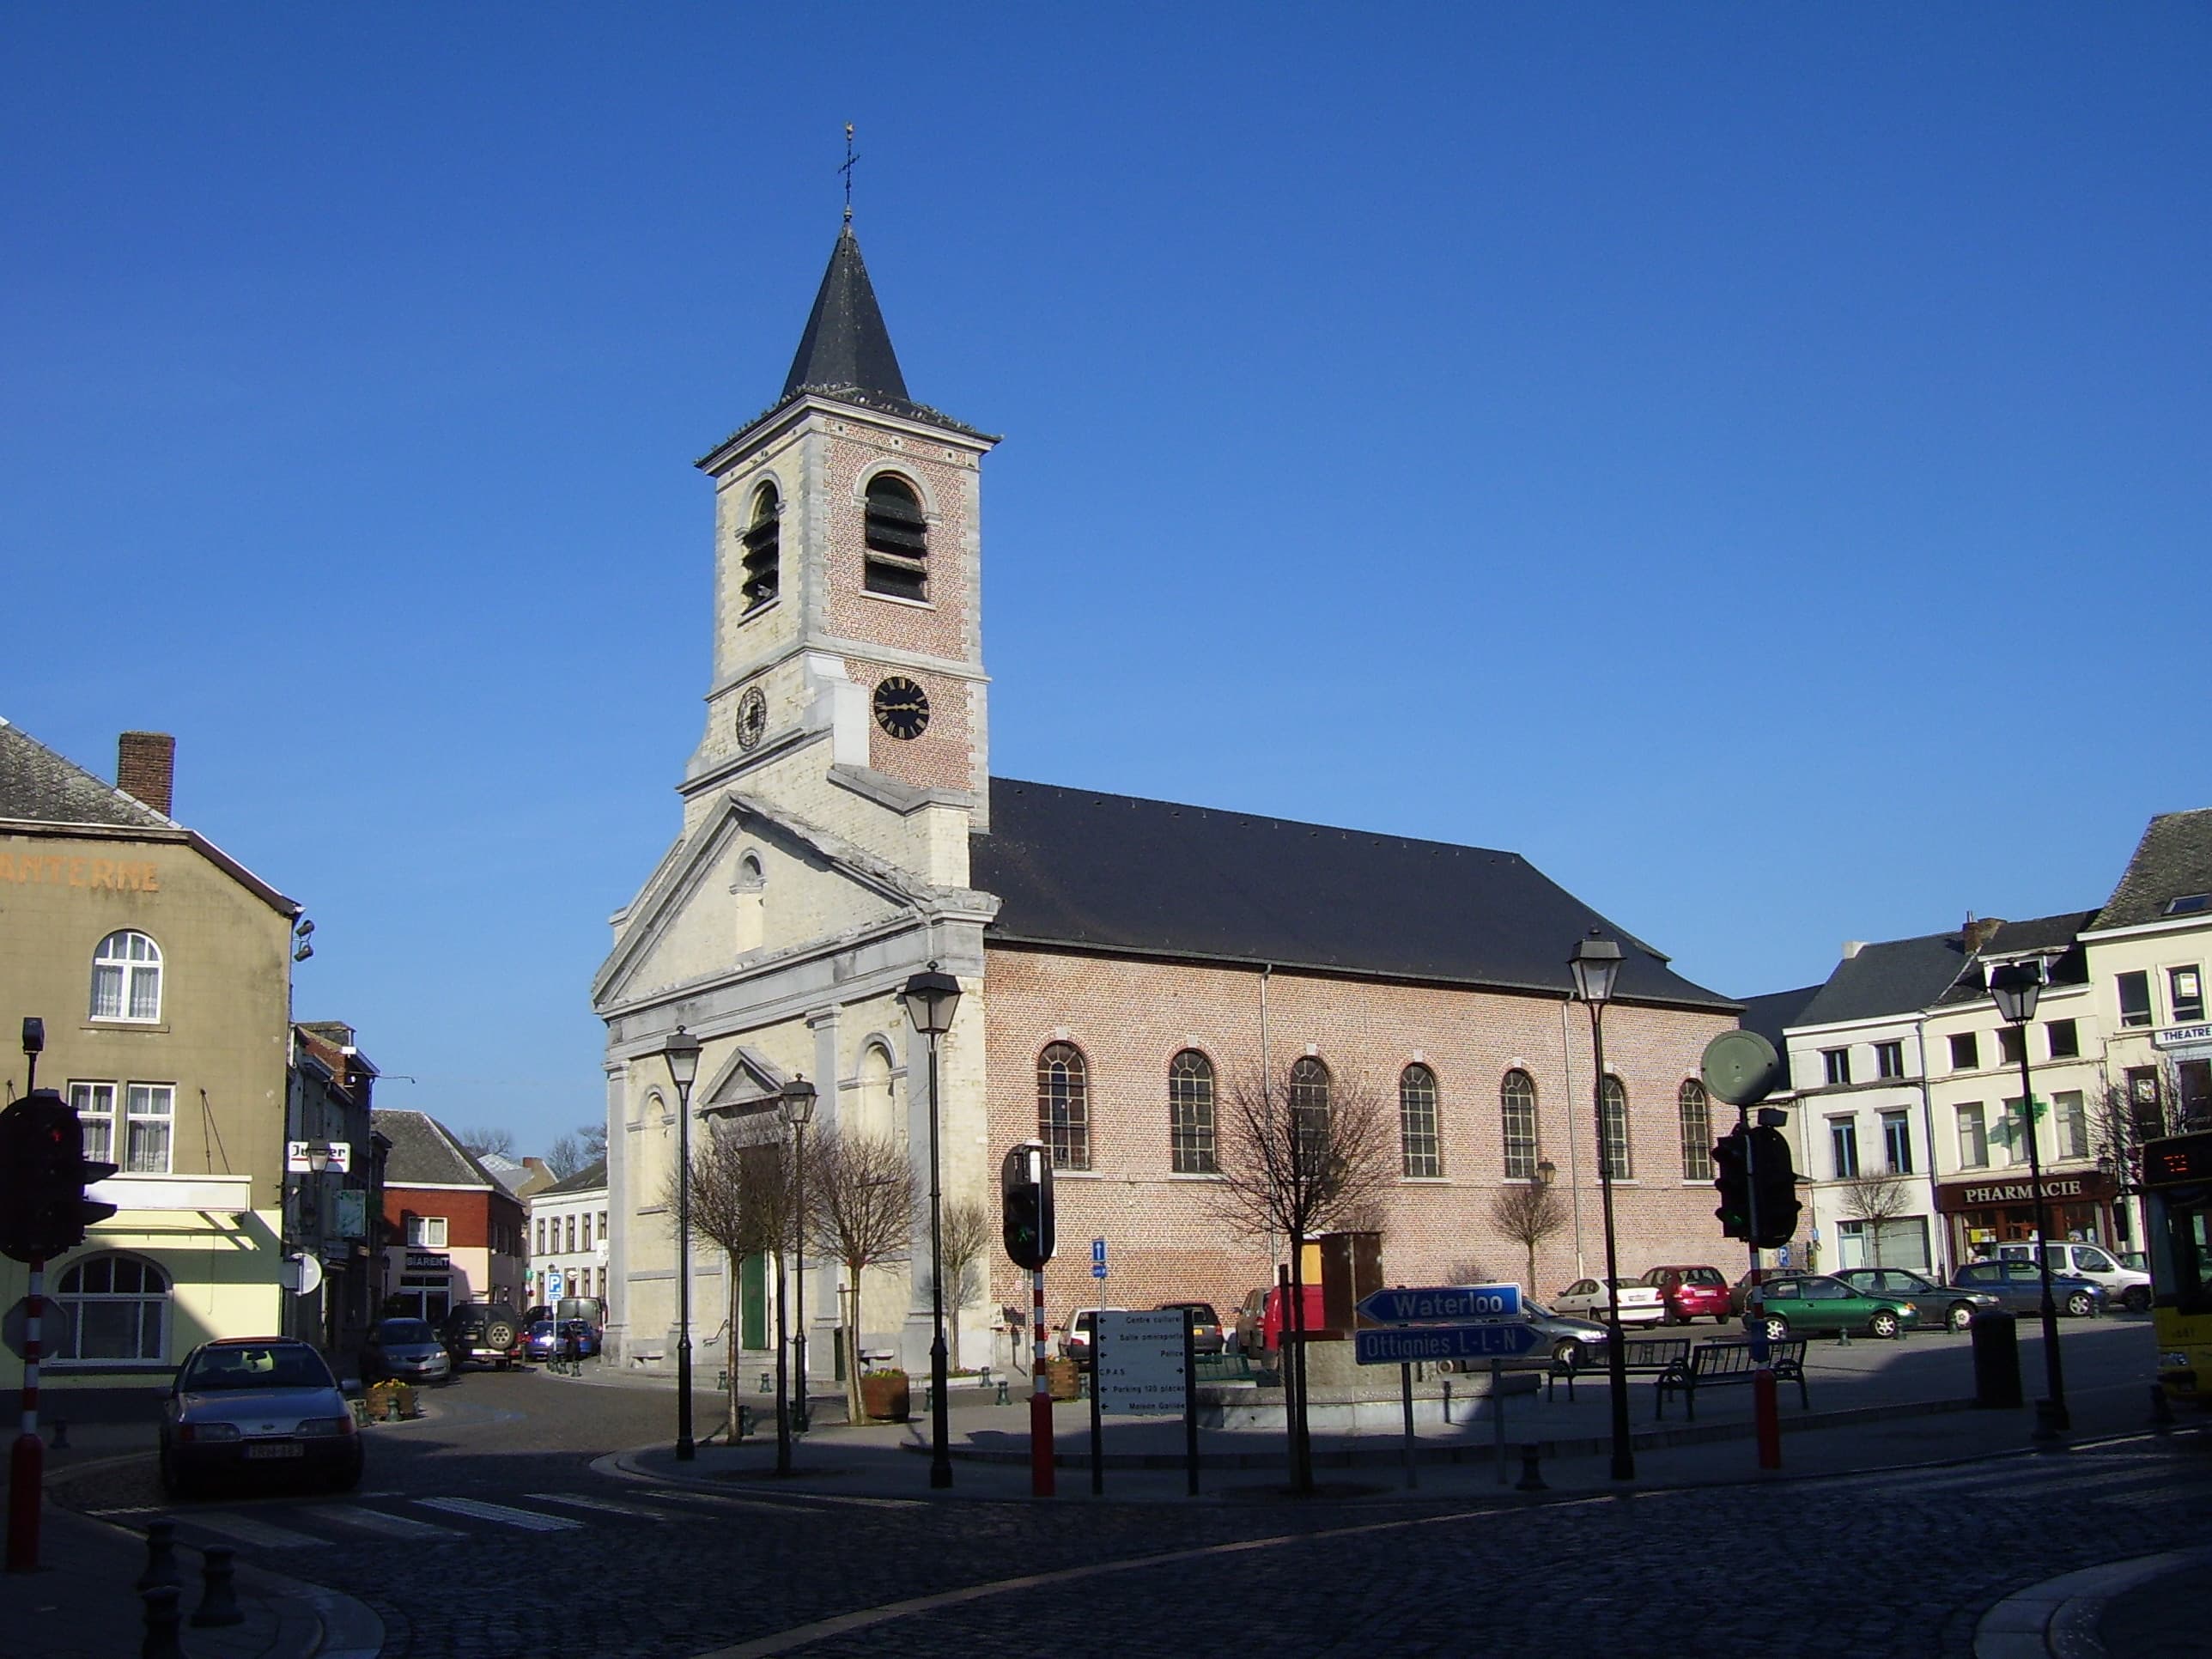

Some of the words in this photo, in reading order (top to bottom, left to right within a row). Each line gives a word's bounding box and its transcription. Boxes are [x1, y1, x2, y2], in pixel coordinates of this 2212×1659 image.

[2163, 1027, 2211, 1041] THEATRE
[550, 1276, 561, 1291] P
[1393, 1291, 1503, 1317] Waterloo
[1366, 1334, 1450, 1358] Ottignies
[1113, 1385, 1141, 1394] Parking
